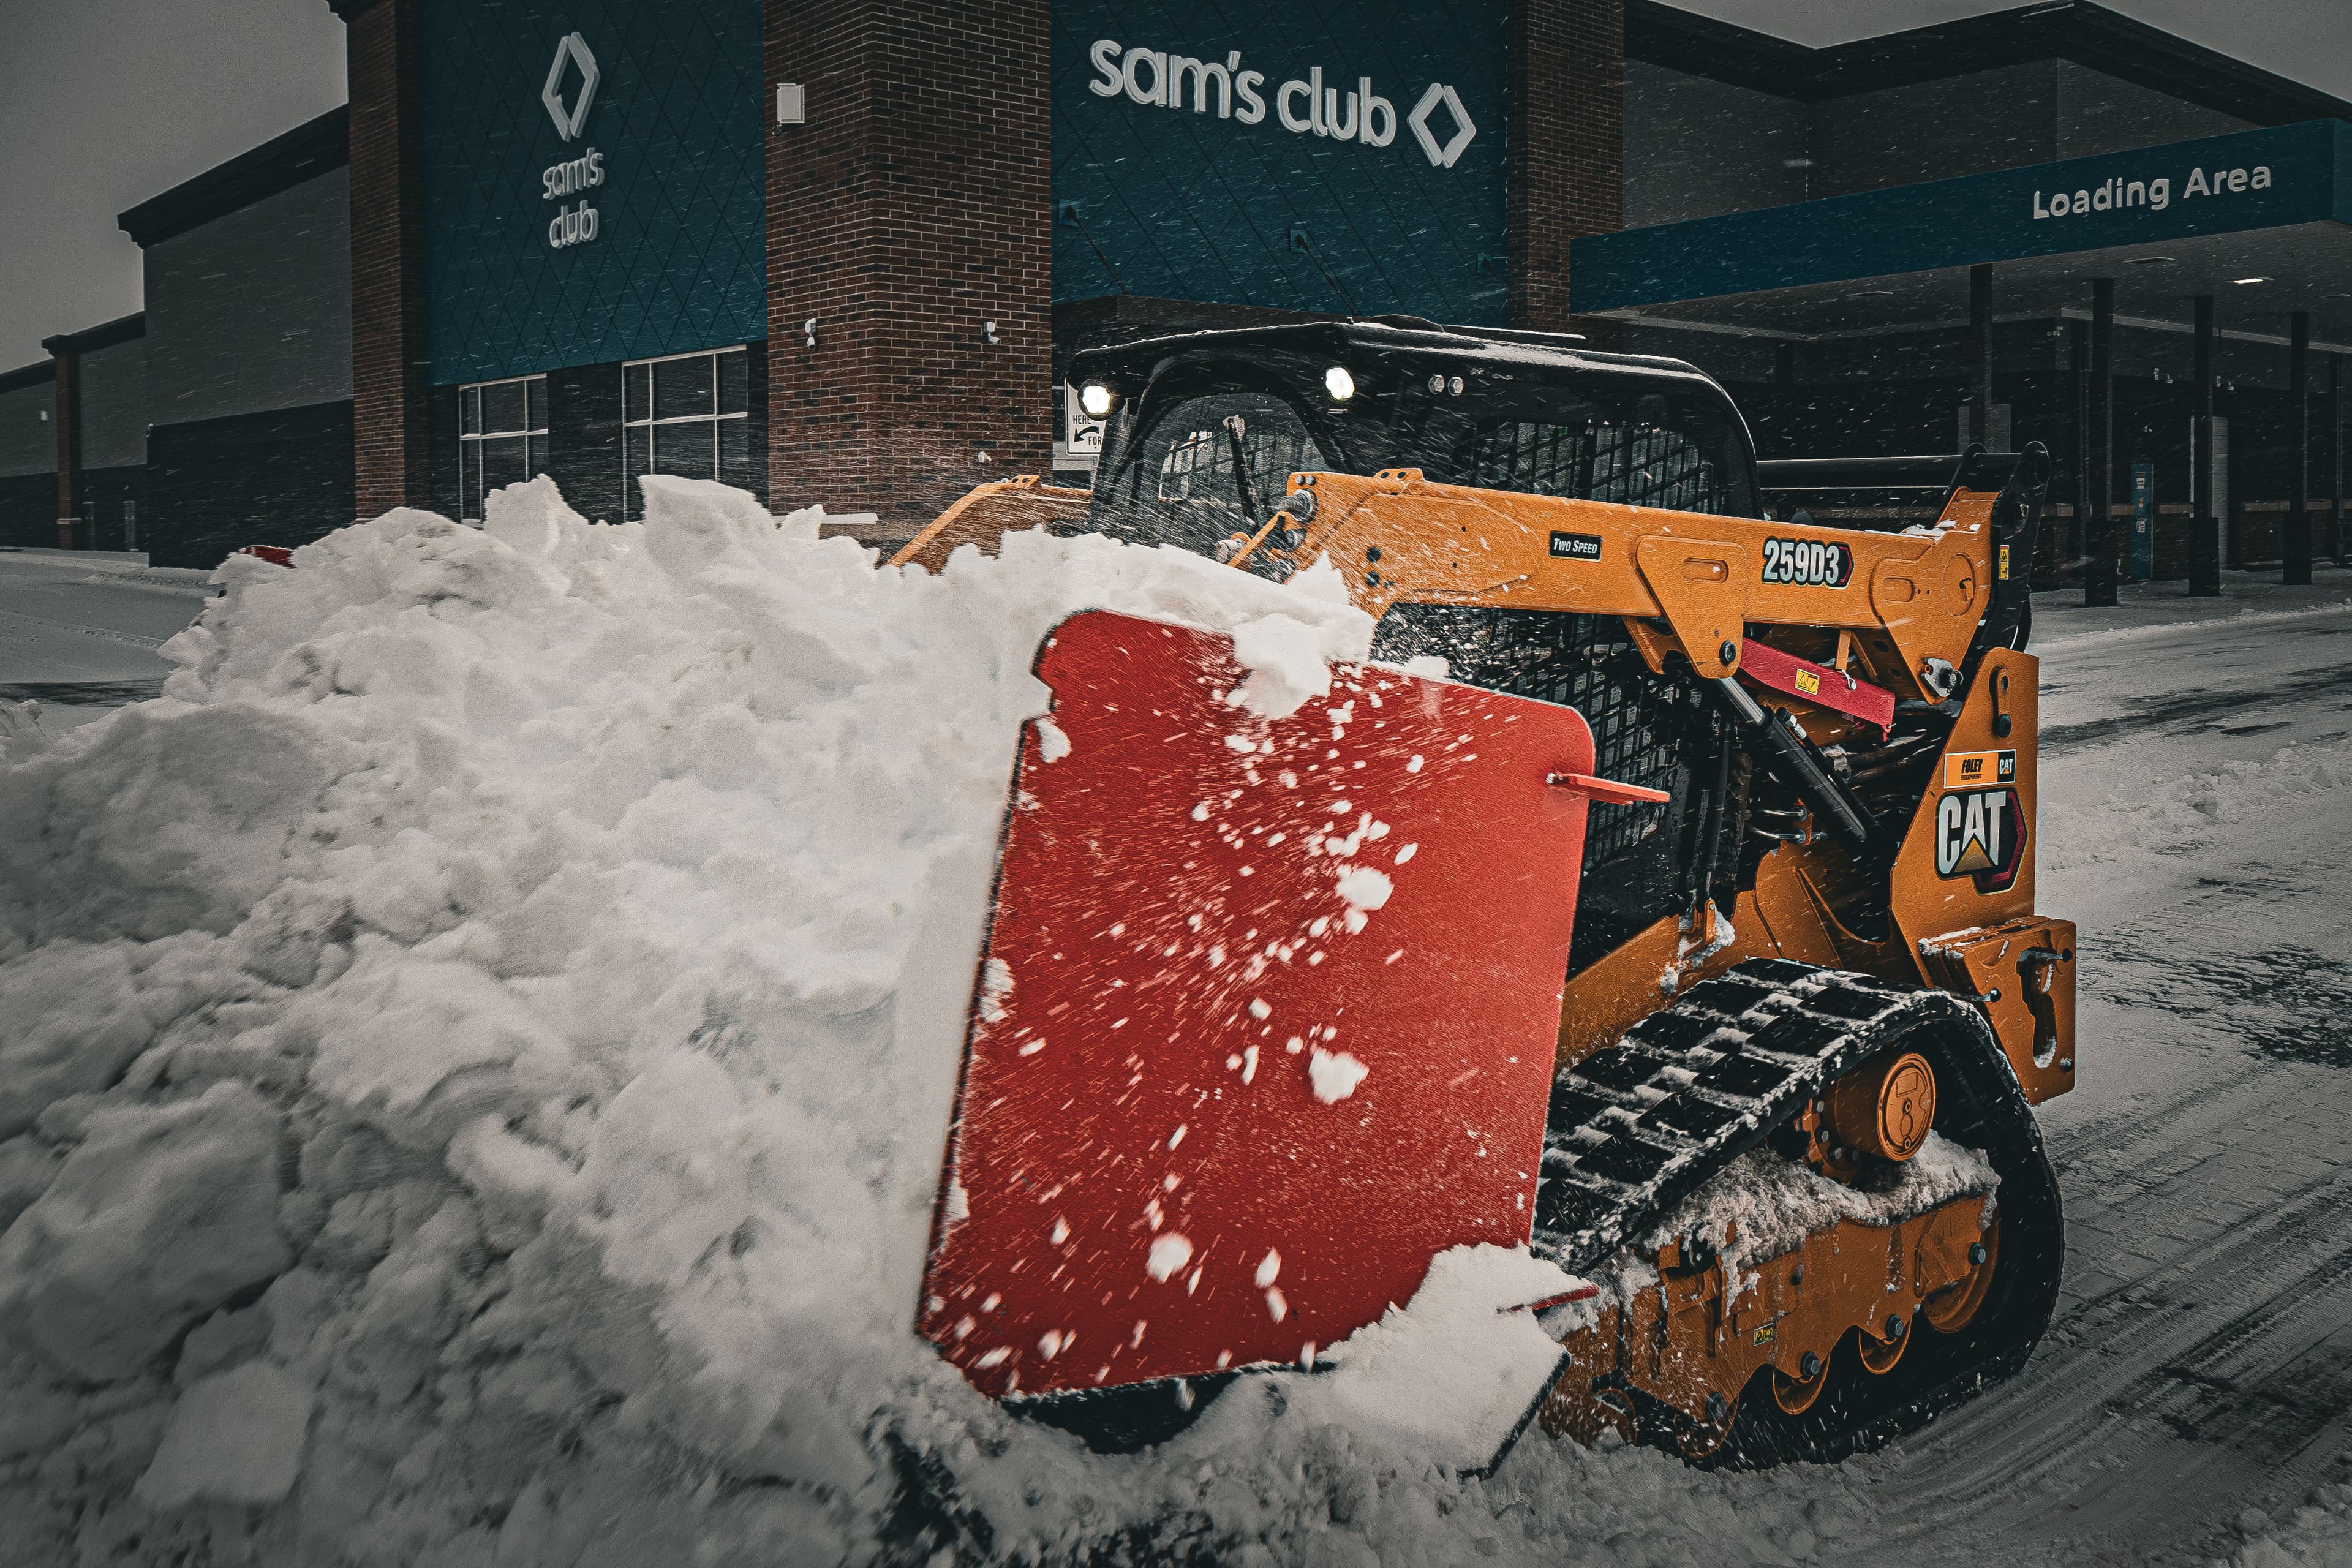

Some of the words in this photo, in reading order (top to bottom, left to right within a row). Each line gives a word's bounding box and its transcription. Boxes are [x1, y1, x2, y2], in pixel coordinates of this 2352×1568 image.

[1089, 39, 1265, 124] sam's
[1276, 66, 1396, 147] club
[543, 147, 605, 200] sam's
[2034, 177, 2169, 219] Loading
[2183, 166, 2271, 198] Area
[549, 200, 599, 249] club
[1072, 415, 1091, 424] HERE
[1088, 436, 1102, 445] FOR
[1763, 540, 1840, 584] 259D3
[1999, 759, 2014, 775] CAT
[1938, 791, 2007, 875] CAT
